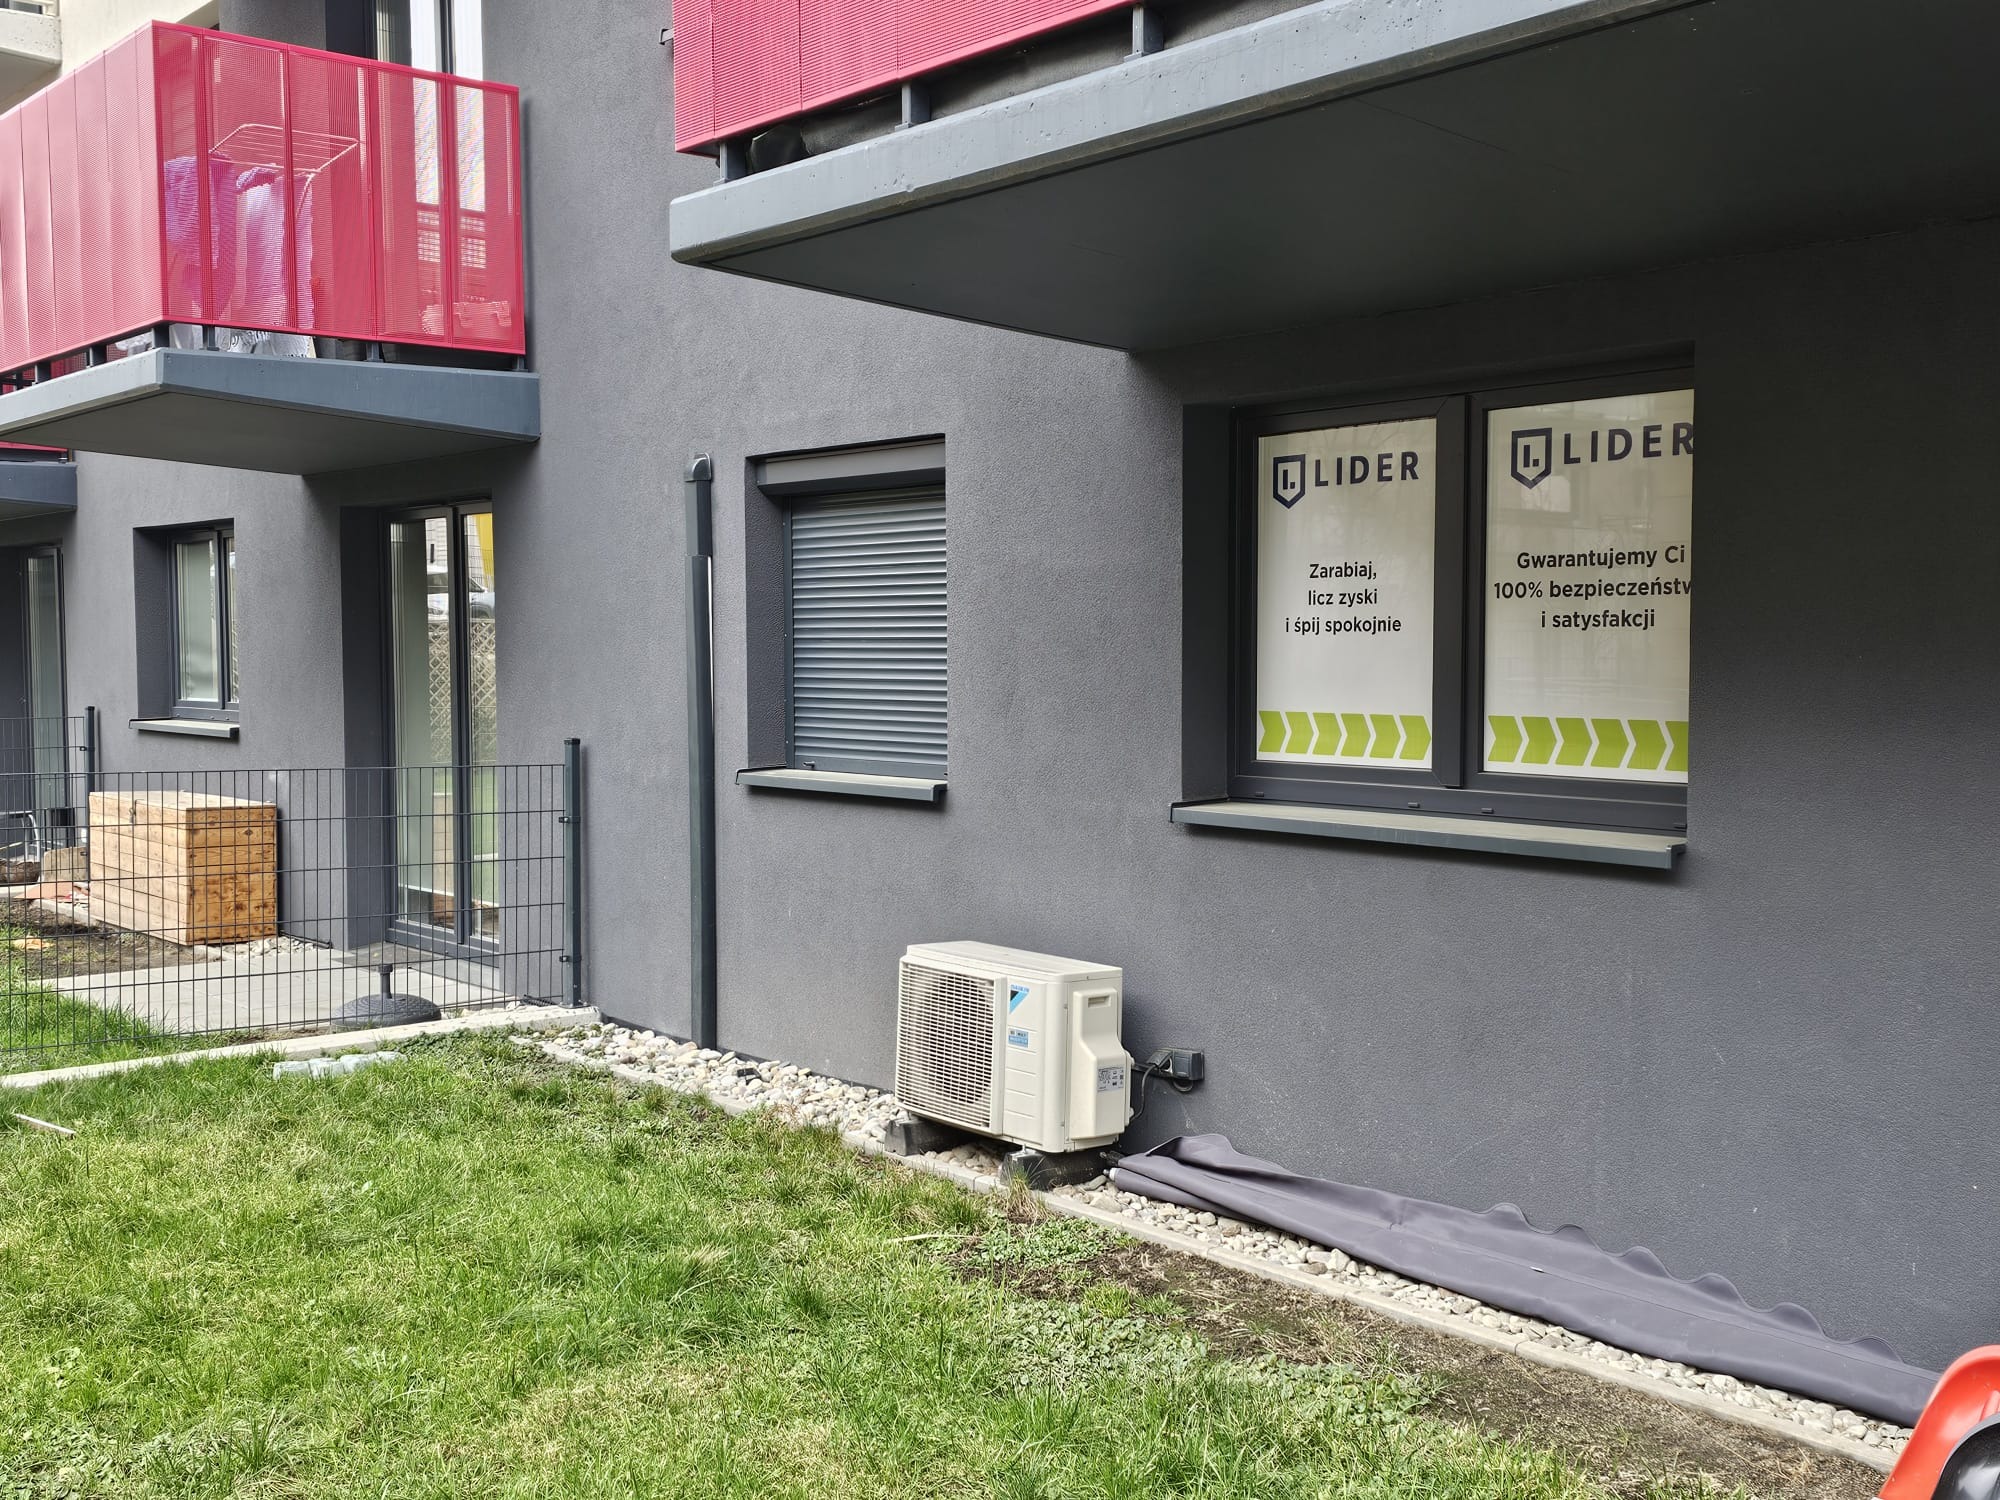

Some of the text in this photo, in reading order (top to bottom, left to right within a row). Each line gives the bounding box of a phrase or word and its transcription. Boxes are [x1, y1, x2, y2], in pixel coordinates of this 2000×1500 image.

[1563, 422, 1695, 465] LIDER
[1314, 451, 1420, 488] LIDER
[1516, 544, 1686, 570] Gwarantujemy Ci
[1309, 560, 1377, 580] Zarabiaj,
[1308, 588, 1378, 608] licz zyski
[1493, 580, 1543, 600] 100%
[1285, 615, 1402, 636] i śpij spokojnie
[1541, 608, 1656, 632] i satysfakcji
